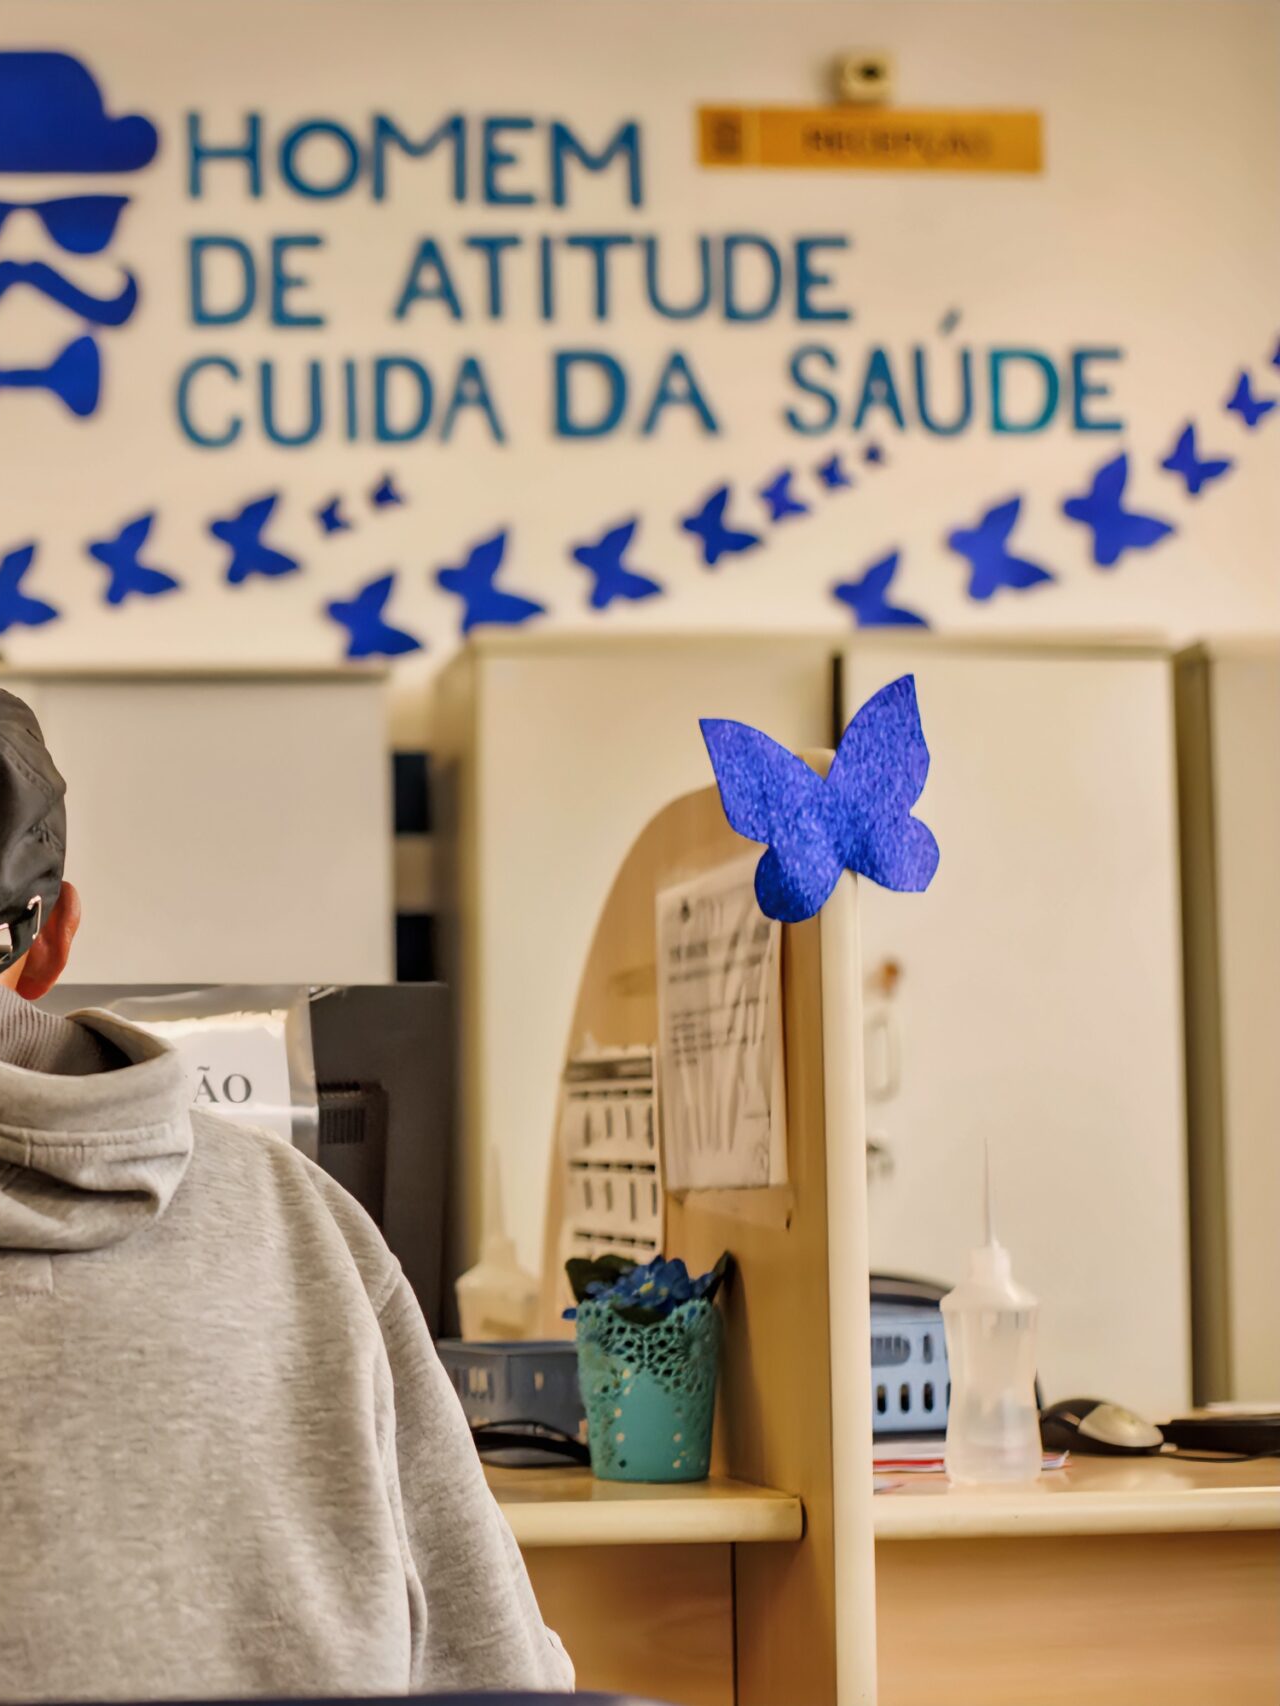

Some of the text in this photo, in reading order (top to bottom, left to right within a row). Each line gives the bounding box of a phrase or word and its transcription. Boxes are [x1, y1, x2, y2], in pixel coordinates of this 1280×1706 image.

[186, 111, 644, 207] HOMEM
[188, 233, 852, 328] DE ATITUDE
[175, 307, 1125, 449] CUIDA DA SAÚDE
[185, 1066, 253, 1105] ÃO
